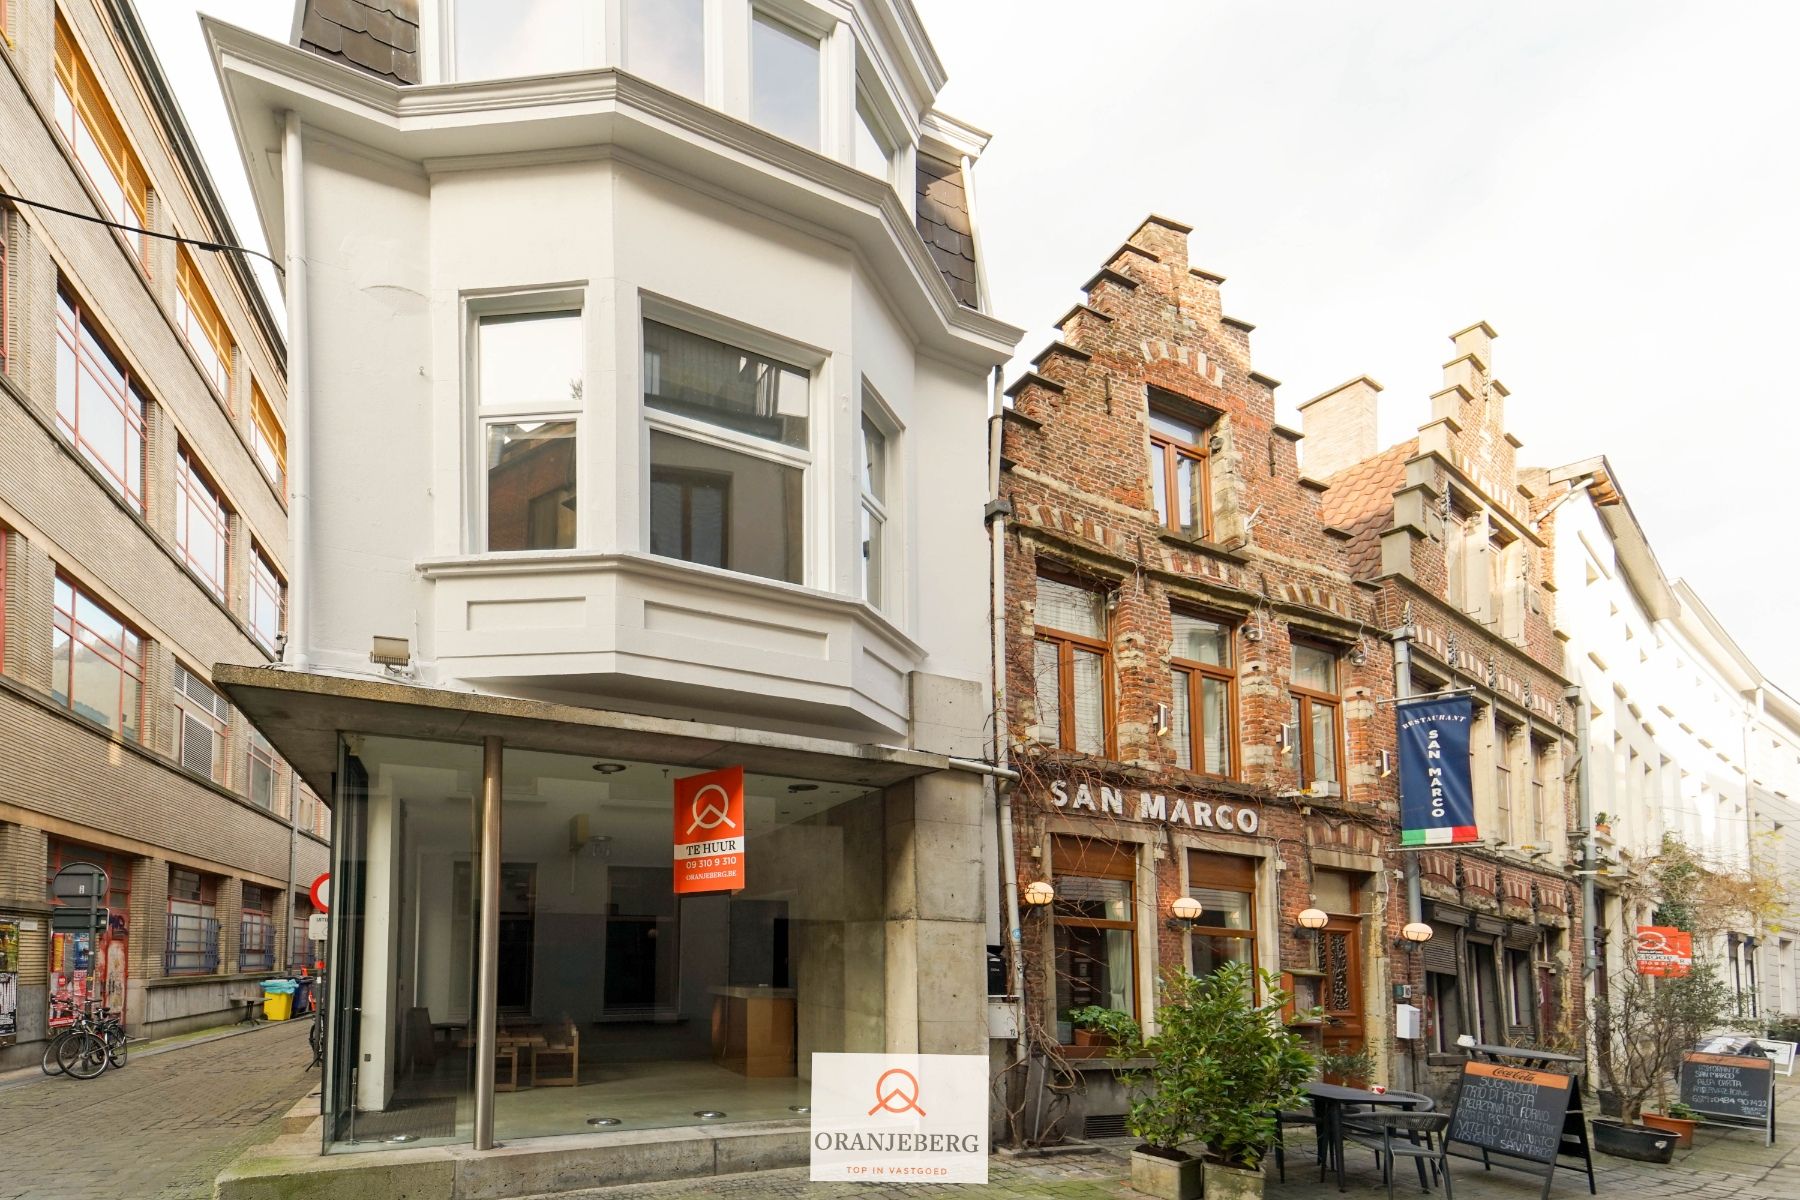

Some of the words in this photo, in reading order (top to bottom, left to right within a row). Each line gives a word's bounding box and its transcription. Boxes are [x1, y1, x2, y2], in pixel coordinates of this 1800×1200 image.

[1402, 714, 1466, 730] RESTAURANT
[1428, 730, 1440, 759] SAN
[1428, 768, 1444, 818] MARCO
[1050, 780, 1123, 814] SAN
[1140, 792, 1258, 834] MARCO
[686, 844, 701, 856] TE
[702, 840, 736, 854] HUUR
[686, 861, 696, 869] 09
[699, 859, 712, 868] 310
[714, 858, 720, 866] 9
[722, 856, 736, 866] 310
[686, 870, 736, 881] ORANJEBERG.BE
[1464, 1085, 1486, 1098] TRIO
[1489, 1088, 1498, 1100] DI
[1502, 1090, 1534, 1107] PASTA
